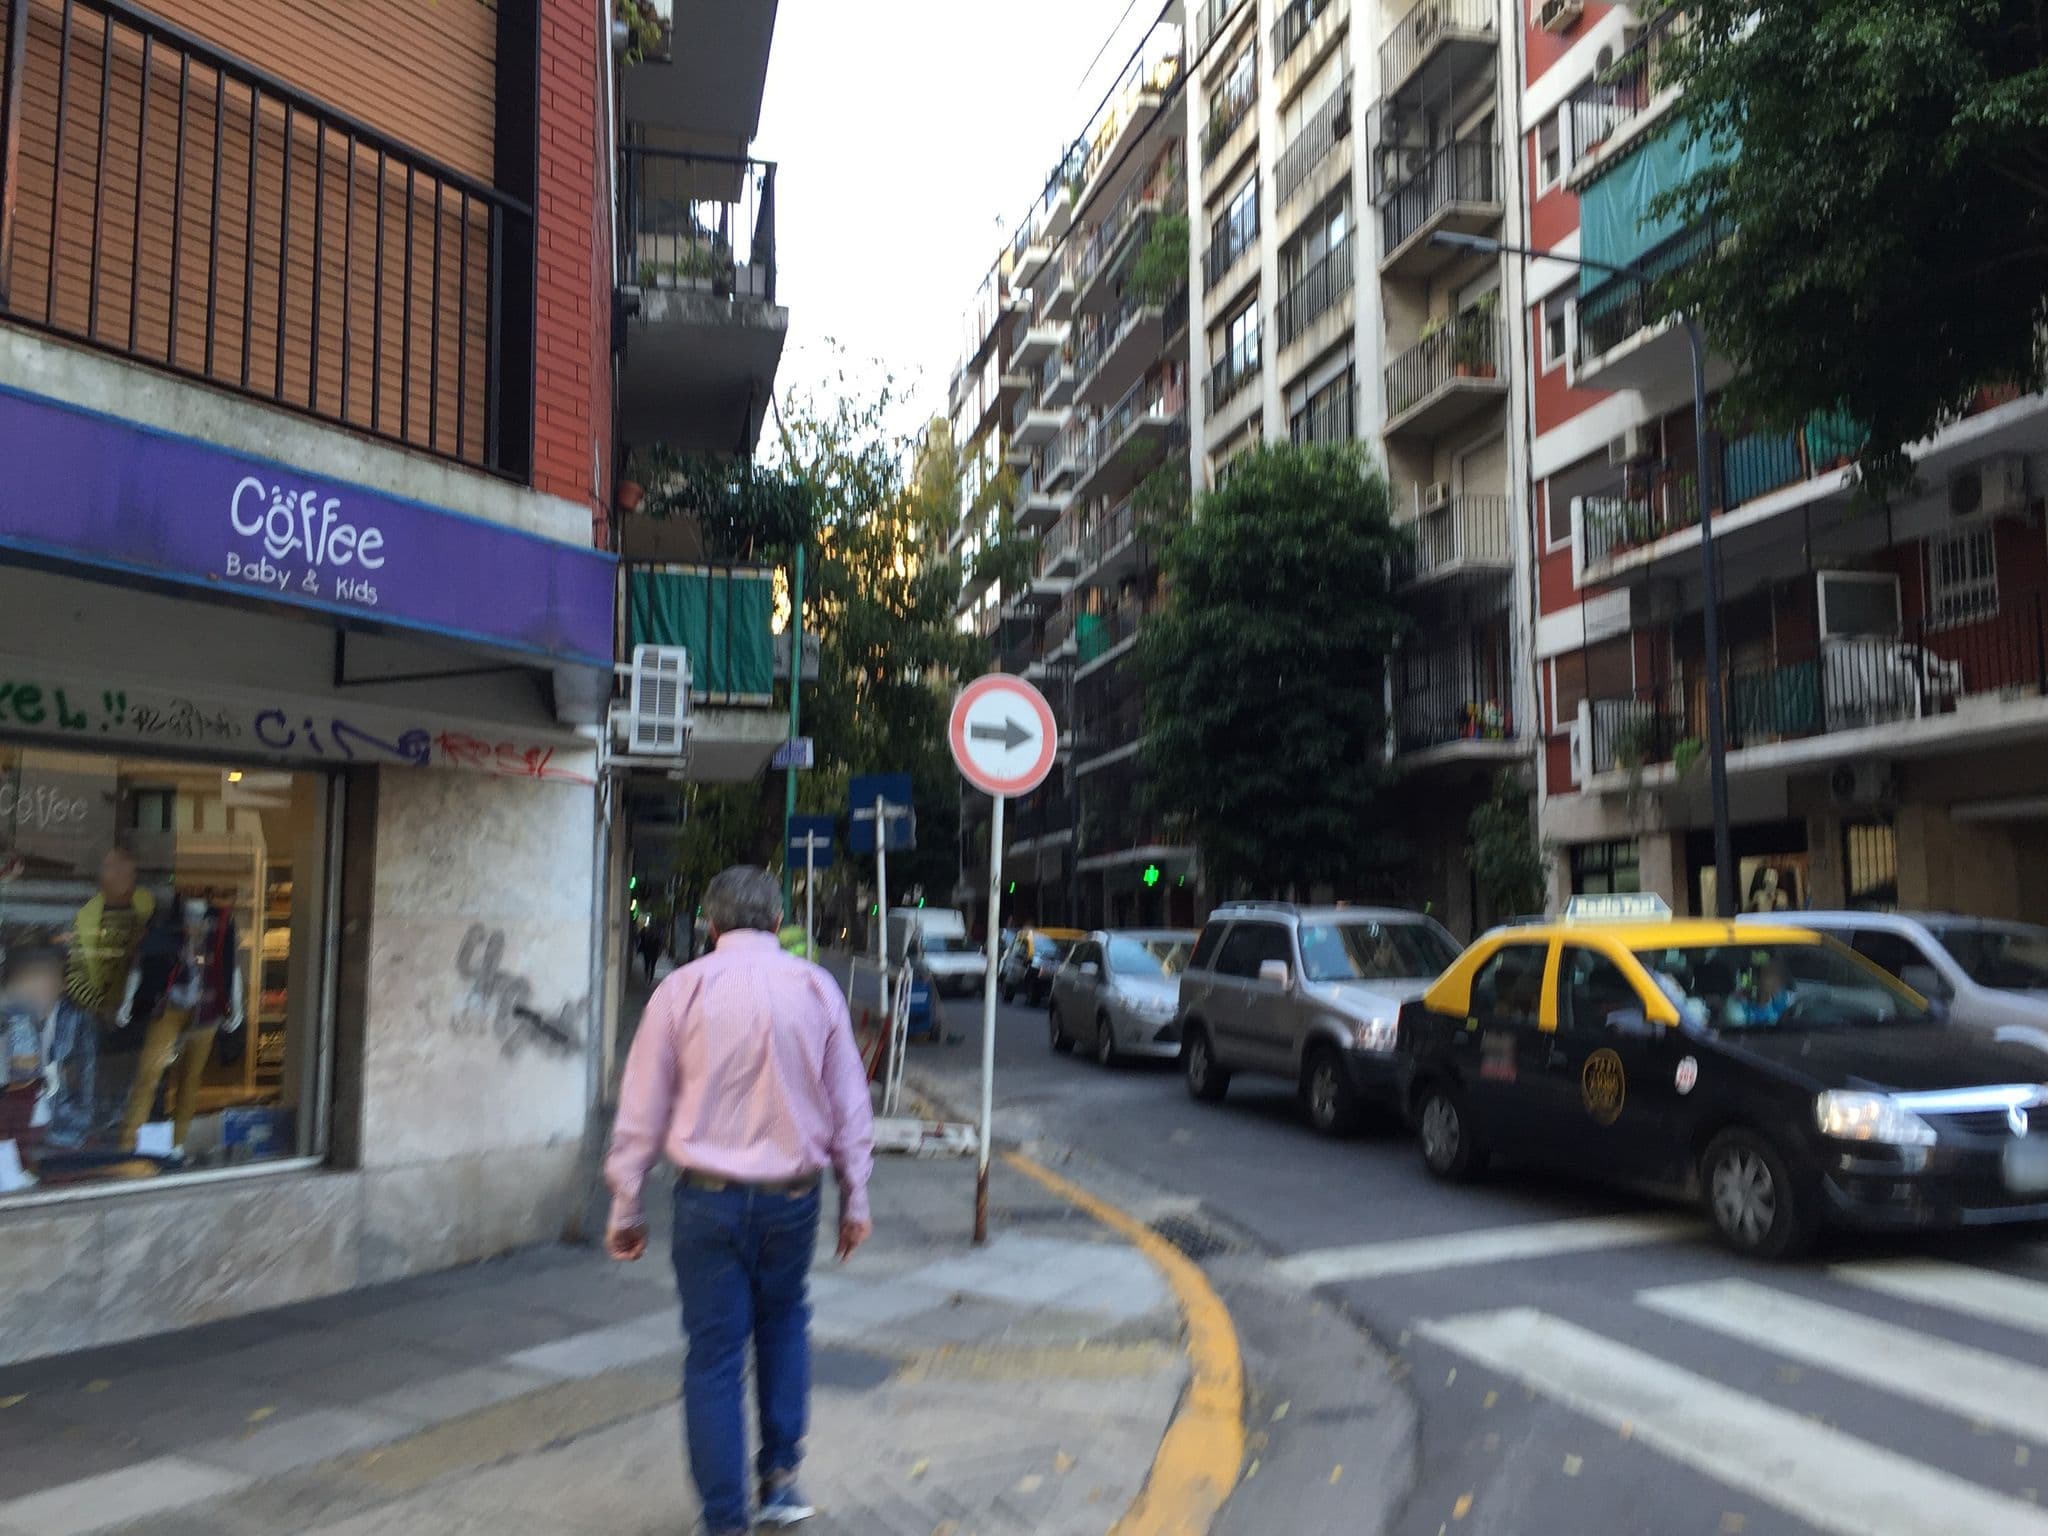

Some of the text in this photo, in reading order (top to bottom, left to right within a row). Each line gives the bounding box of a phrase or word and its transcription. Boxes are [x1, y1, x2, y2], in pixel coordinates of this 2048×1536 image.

[231, 476, 385, 569] Coffee
[226, 551, 378, 606] Baby & Kids
